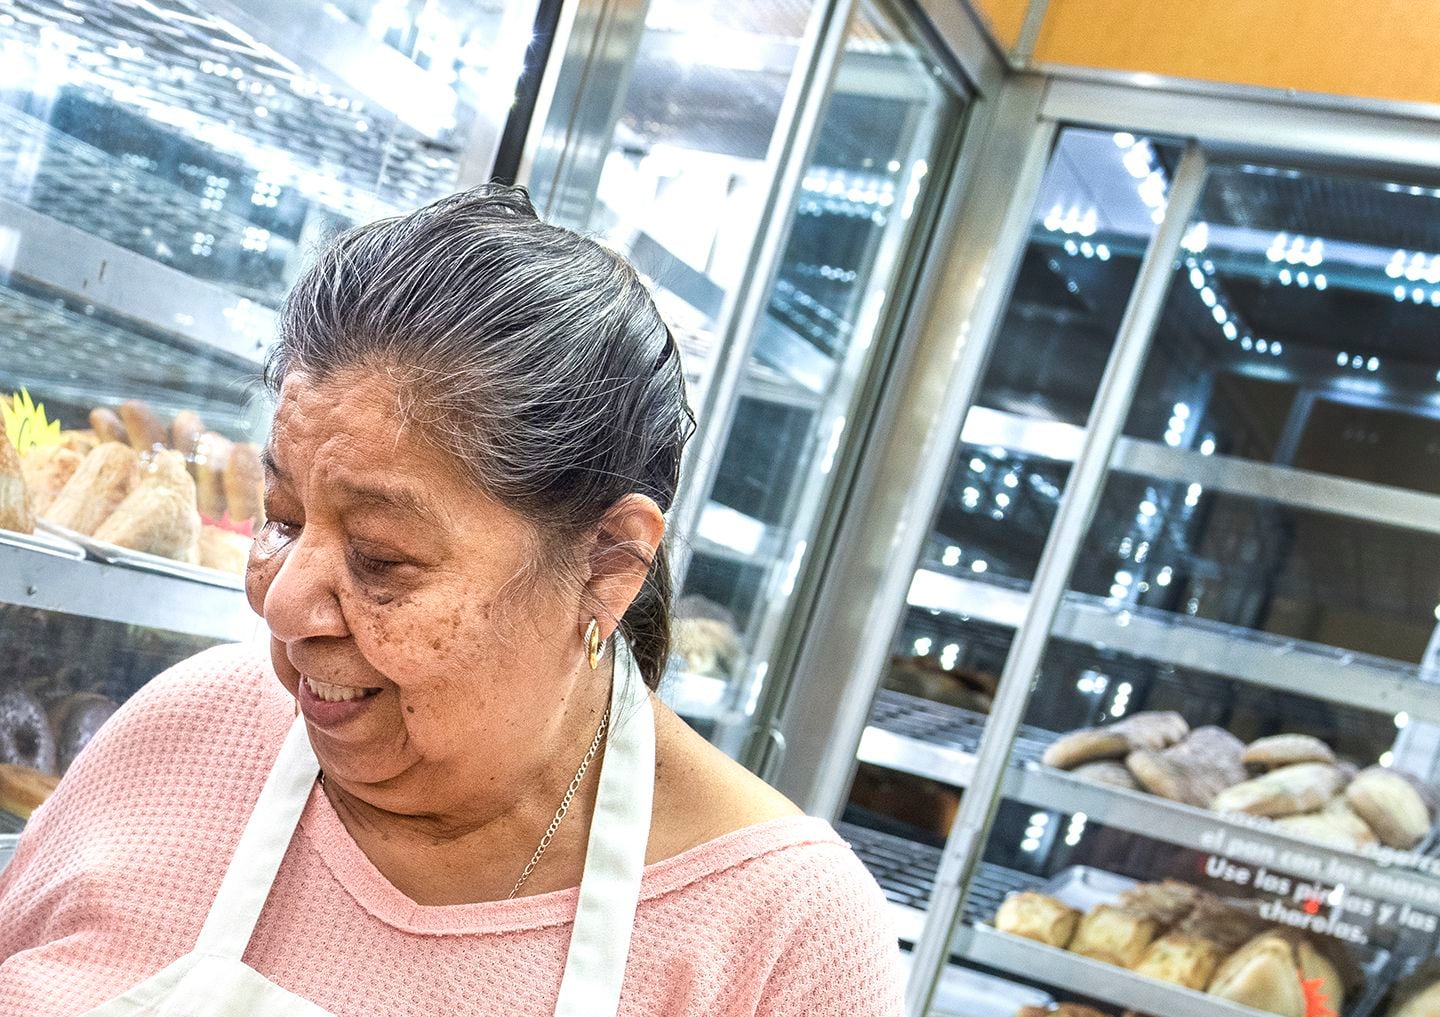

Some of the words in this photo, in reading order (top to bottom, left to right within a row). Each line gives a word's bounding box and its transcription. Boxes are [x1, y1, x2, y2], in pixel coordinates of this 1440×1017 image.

[1200, 829, 1225, 849] el
[1206, 856, 1251, 885] Use
[1253, 868, 1291, 896] las
[1292, 880, 1374, 917] pinas
[1376, 902, 1395, 926] y
[1399, 902, 1438, 934] las
